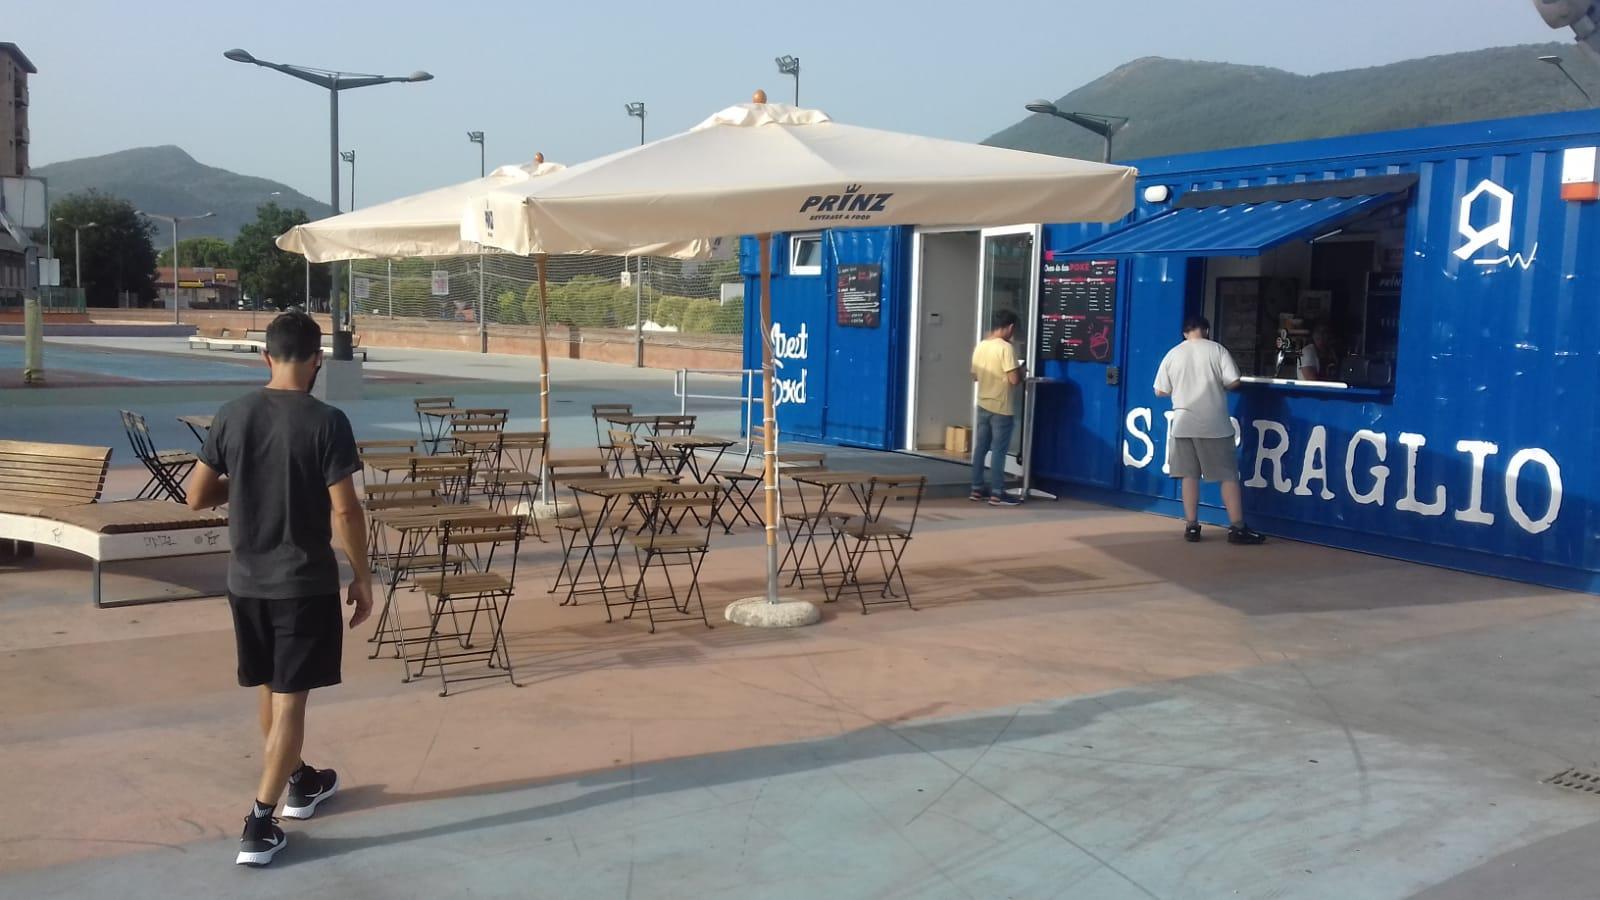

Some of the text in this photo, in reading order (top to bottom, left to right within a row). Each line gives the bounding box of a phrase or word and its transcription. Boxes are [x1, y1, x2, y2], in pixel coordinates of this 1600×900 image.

[800, 193, 893, 213] PRINZ
[850, 213, 871, 221] FOOD
[1123, 406, 1563, 535] SRAGLIO
